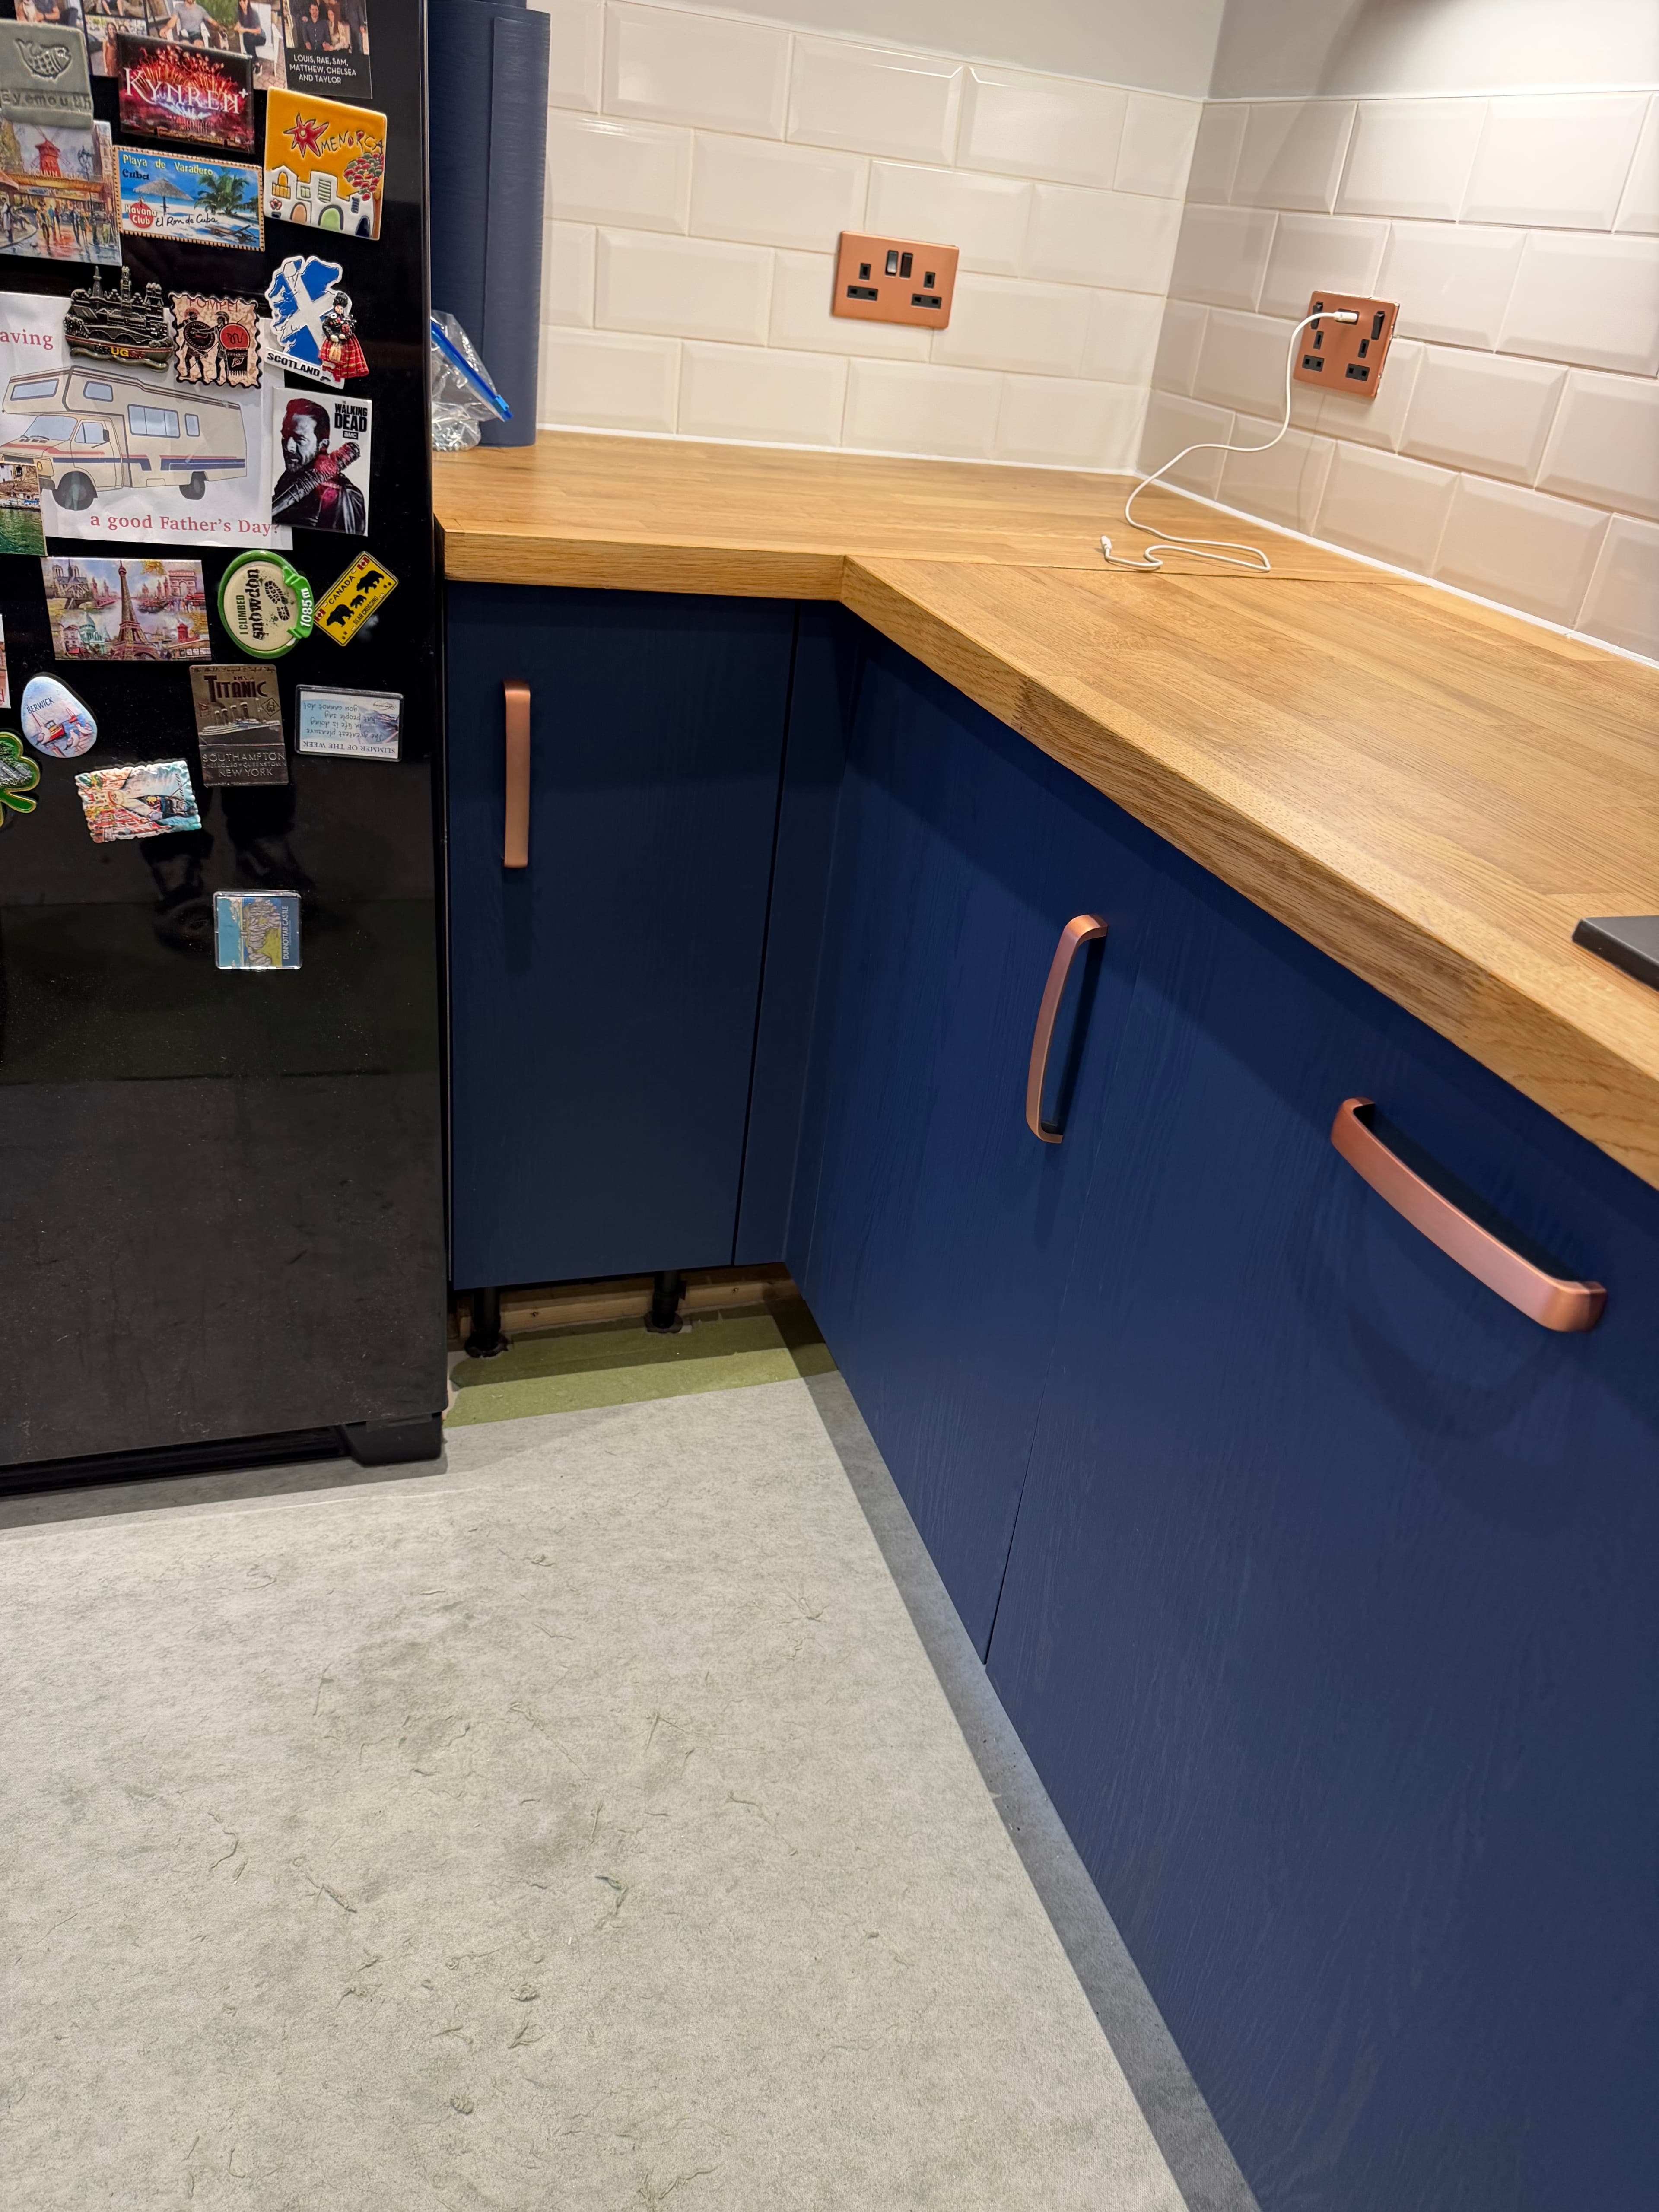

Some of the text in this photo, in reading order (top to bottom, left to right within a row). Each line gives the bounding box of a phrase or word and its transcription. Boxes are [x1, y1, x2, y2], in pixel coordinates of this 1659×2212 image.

[294, 54, 349, 67] LOUIS, RAE, SAM,
[289, 64, 357, 76] MATTHEW, CHELSEA
[315, 75, 341, 84] TAYLOR
[123, 67, 240, 114] KYNREN
[1, 89, 92, 109] Eyemouth
[321, 130, 383, 155] MENORCA
[122, 154, 213, 176] Playa de Varadero
[122, 169, 149, 180] Cuba
[125, 203, 157, 217] Havana
[132, 215, 151, 225] Club
[155, 213, 218, 227] El Ron de Cuba
[267, 353, 320, 376] SCOTLAND
[335, 403, 368, 417] WALKING
[334, 413, 367, 432] DEAD
[90, 514, 280, 536] a good Father's Day?
[328, 575, 356, 604] CANADA
[245, 569, 264, 640] snowdon
[353, 596, 379, 625] BEAR CROSSING
[236, 594, 248, 630] CLIMBED
[27, 696, 55, 714] BERWICK
[310, 717, 329, 727] doing
[340, 712, 361, 721] people
[306, 728, 336, 737] pleasure
[342, 722, 352, 730] life
[338, 731, 370, 739] greatest
[303, 741, 326, 749] WEEK
[360, 745, 395, 753] SLIMMER
[202, 752, 286, 762] SOUTHAMPTON
[219, 767, 273, 777] NEW YORK
